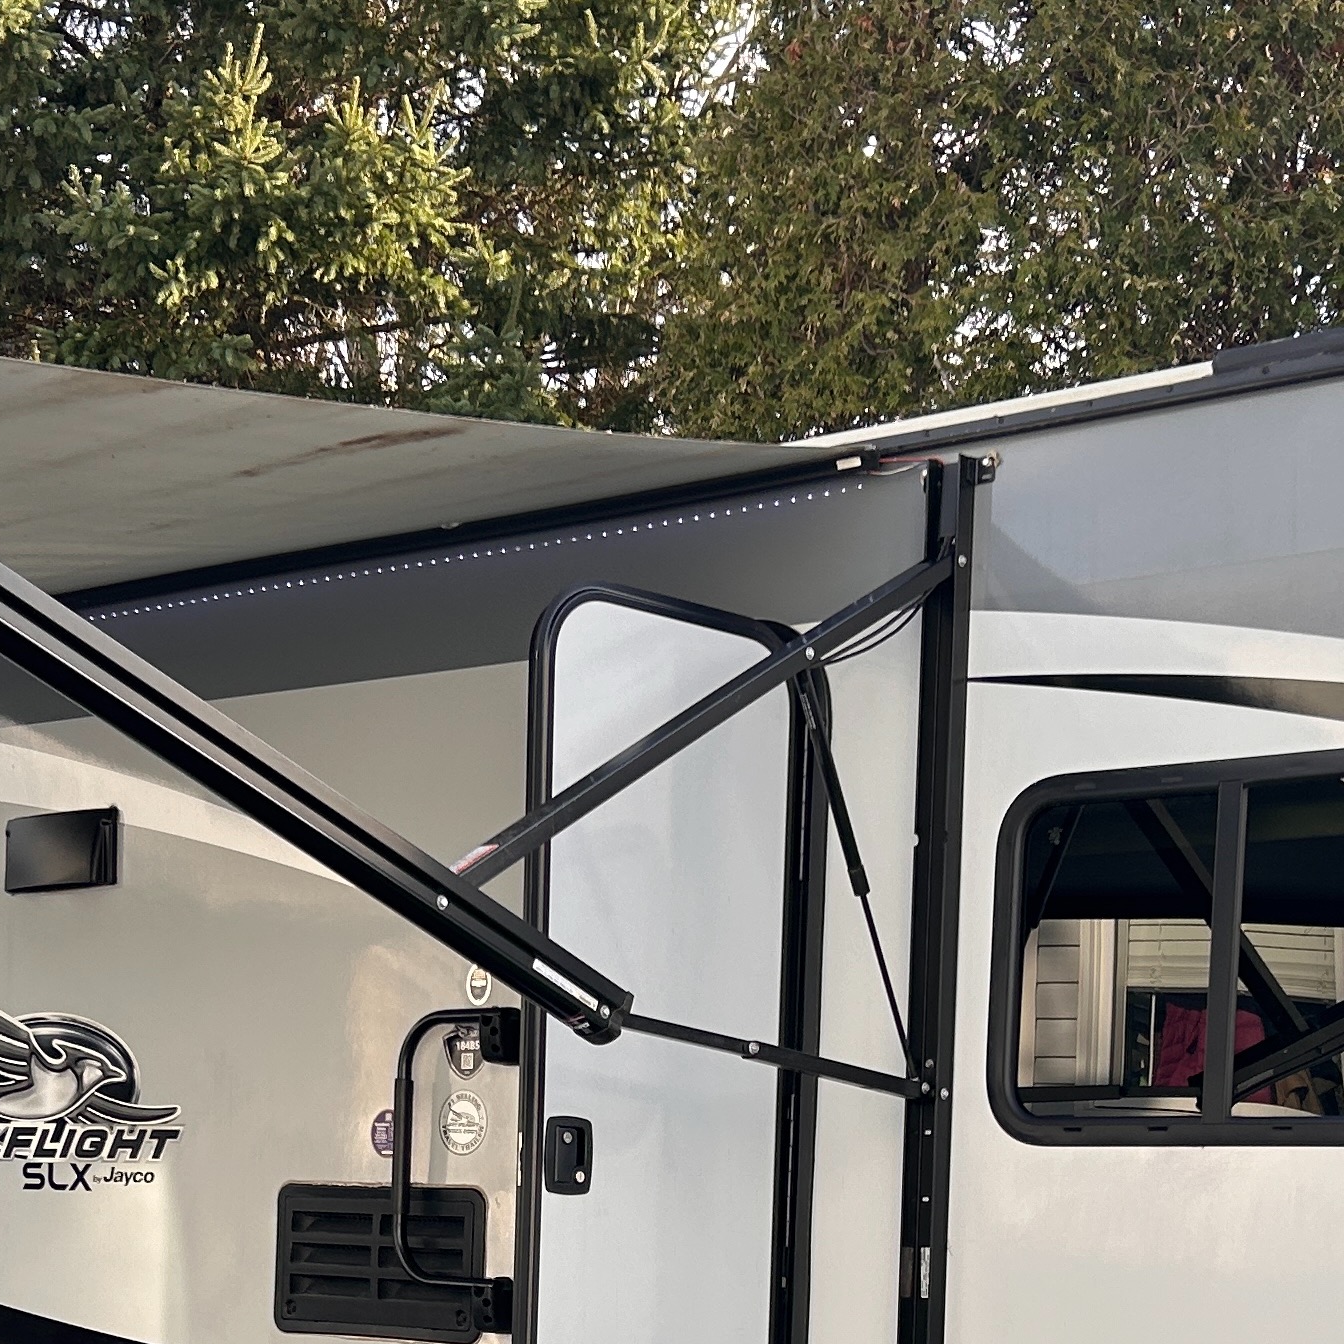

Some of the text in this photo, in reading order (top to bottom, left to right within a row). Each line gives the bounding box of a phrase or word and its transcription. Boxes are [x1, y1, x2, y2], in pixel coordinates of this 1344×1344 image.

[22, 1162, 155, 1191] SLX by Jayco
